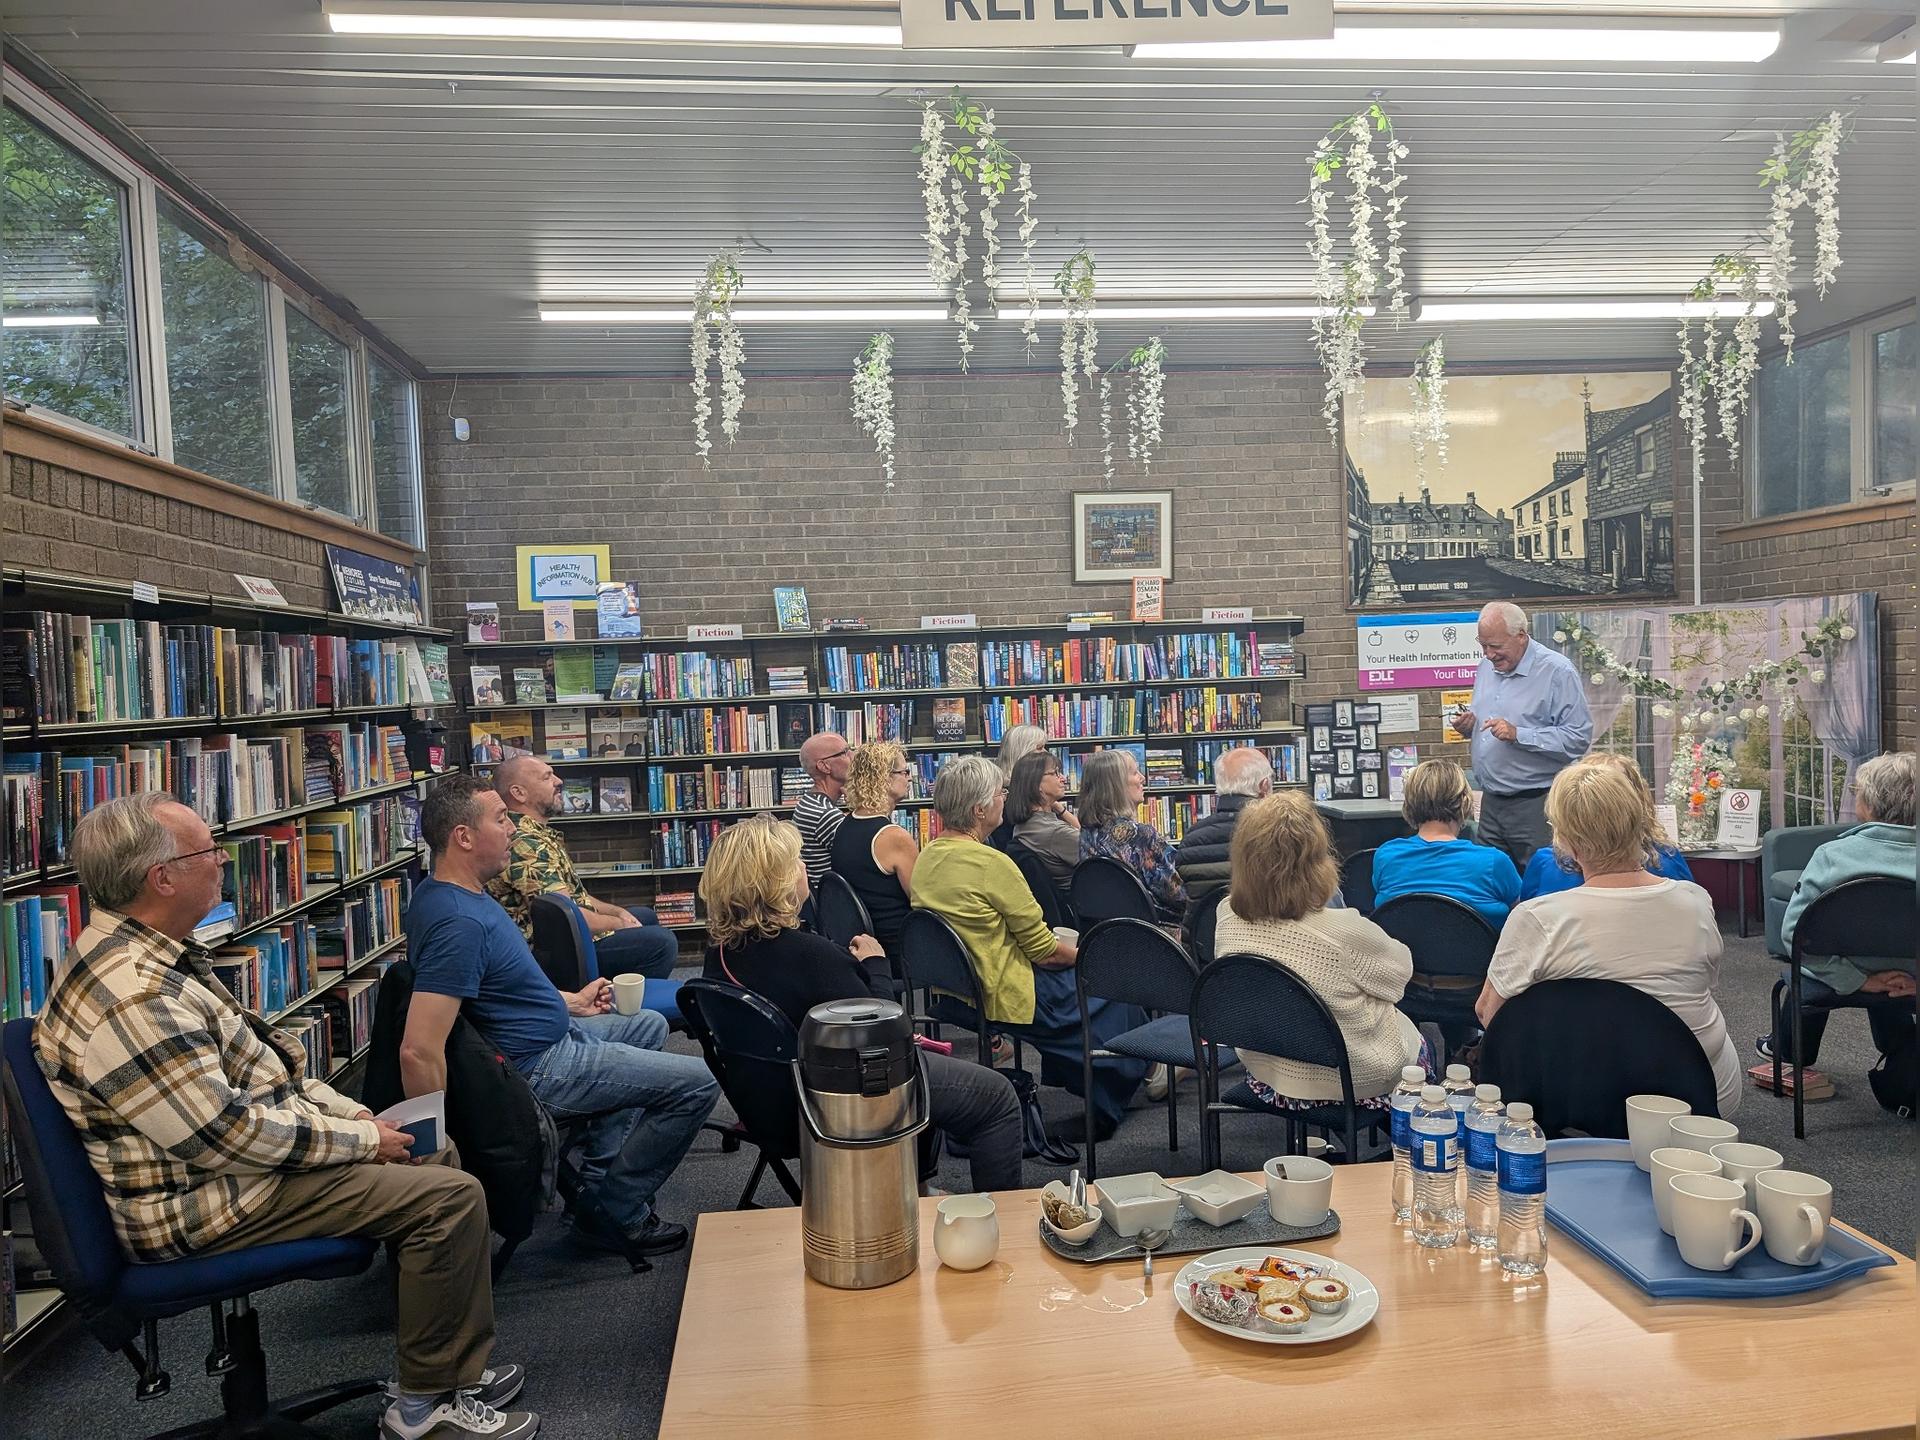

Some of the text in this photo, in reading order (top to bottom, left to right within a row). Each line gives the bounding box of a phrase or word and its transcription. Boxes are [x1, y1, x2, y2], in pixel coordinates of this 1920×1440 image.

[549, 563, 580, 572] HEALTH
[537, 571, 595, 588] INFORMATION HUB
[245, 581, 280, 596] Fiction
[1453, 582, 1468, 590] 1920
[1211, 611, 1245, 619] Fiction
[932, 617, 966, 625] Fiction
[696, 628, 734, 637] Fiction
[1366, 654, 1387, 664] Your
[1389, 653, 1417, 663] Health
[1420, 651, 1470, 662] Information
[1433, 669, 1456, 679] Your
[1457, 669, 1477, 678] libr
